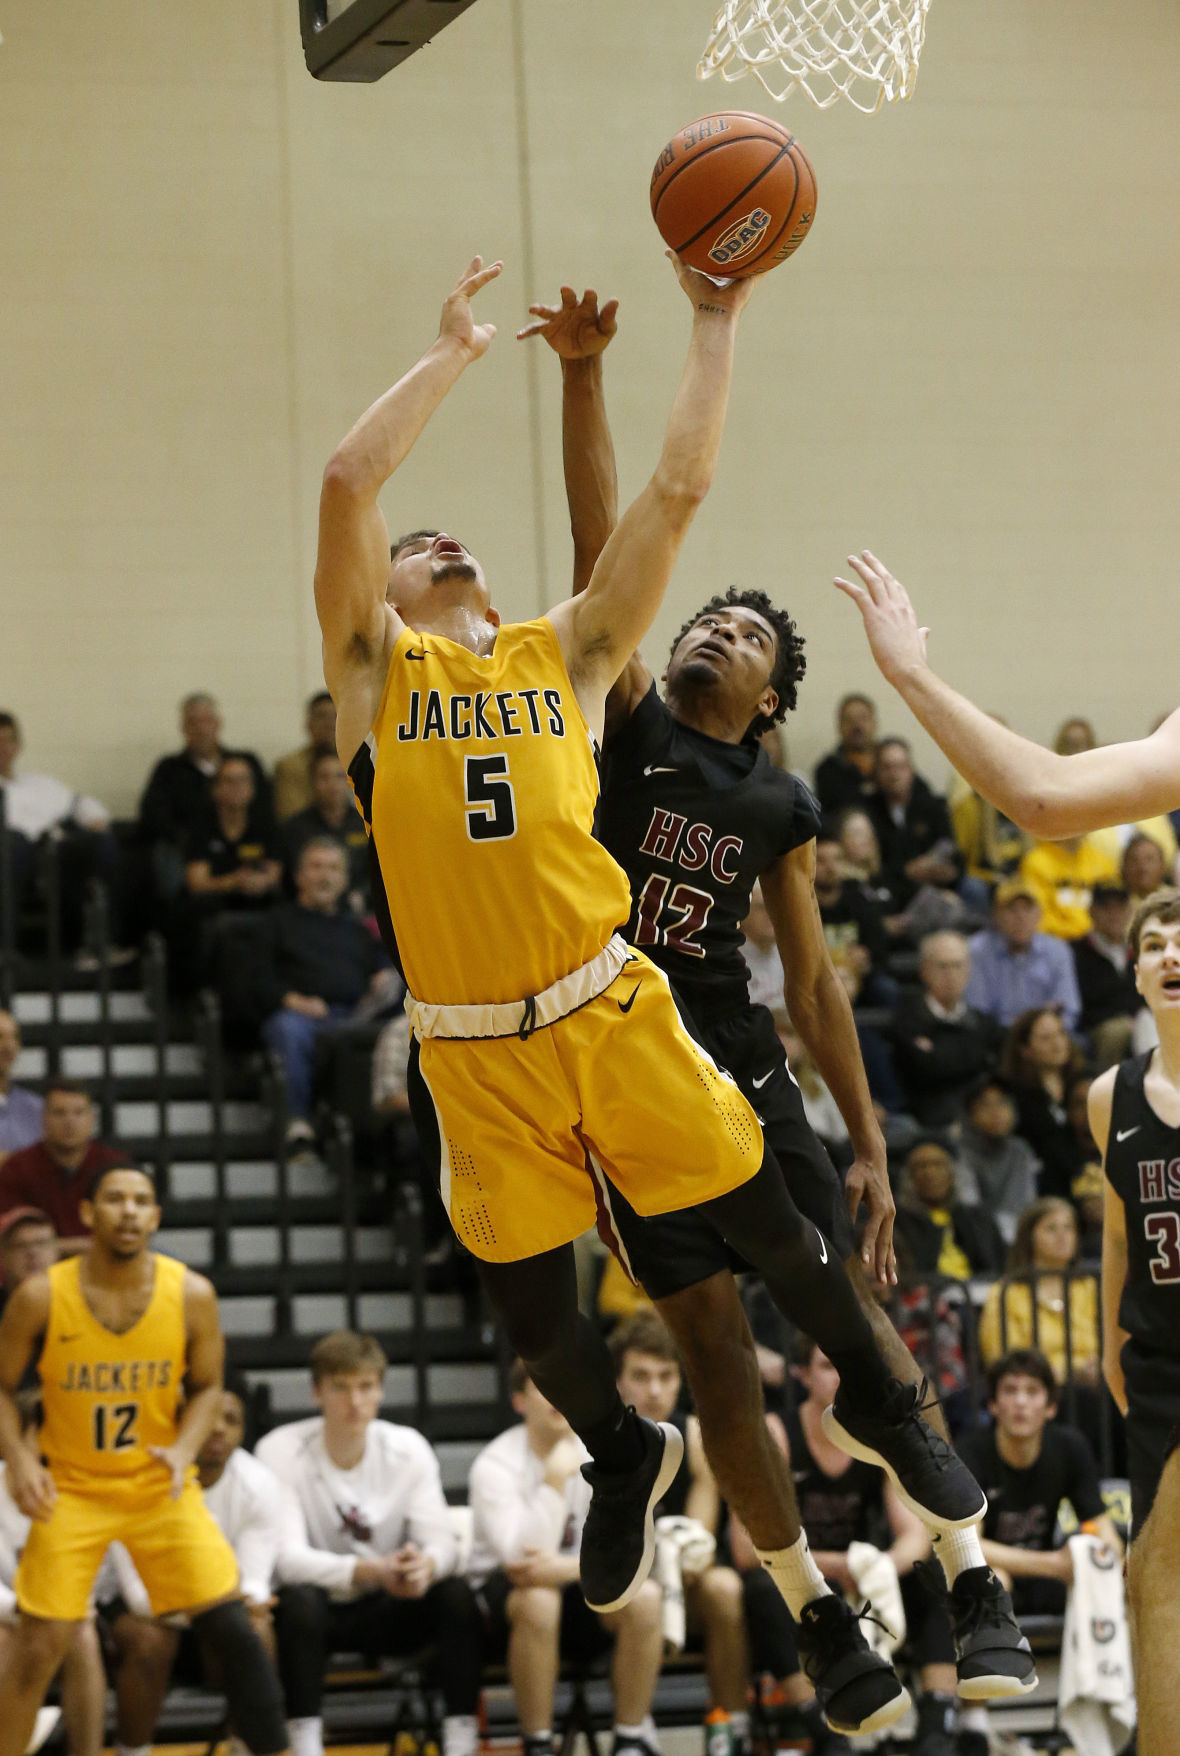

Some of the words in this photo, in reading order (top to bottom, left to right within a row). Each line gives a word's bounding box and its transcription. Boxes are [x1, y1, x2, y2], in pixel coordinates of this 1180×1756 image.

[683, 119, 730, 150] THE
[708, 208, 771, 264] ODAC
[397, 688, 566, 742] JACKETS
[464, 752, 518, 843] 5
[639, 806, 744, 885] HSC
[633, 872, 715, 959] 12
[60, 1358, 173, 1394] JACKETS
[92, 1402, 140, 1453] 12
